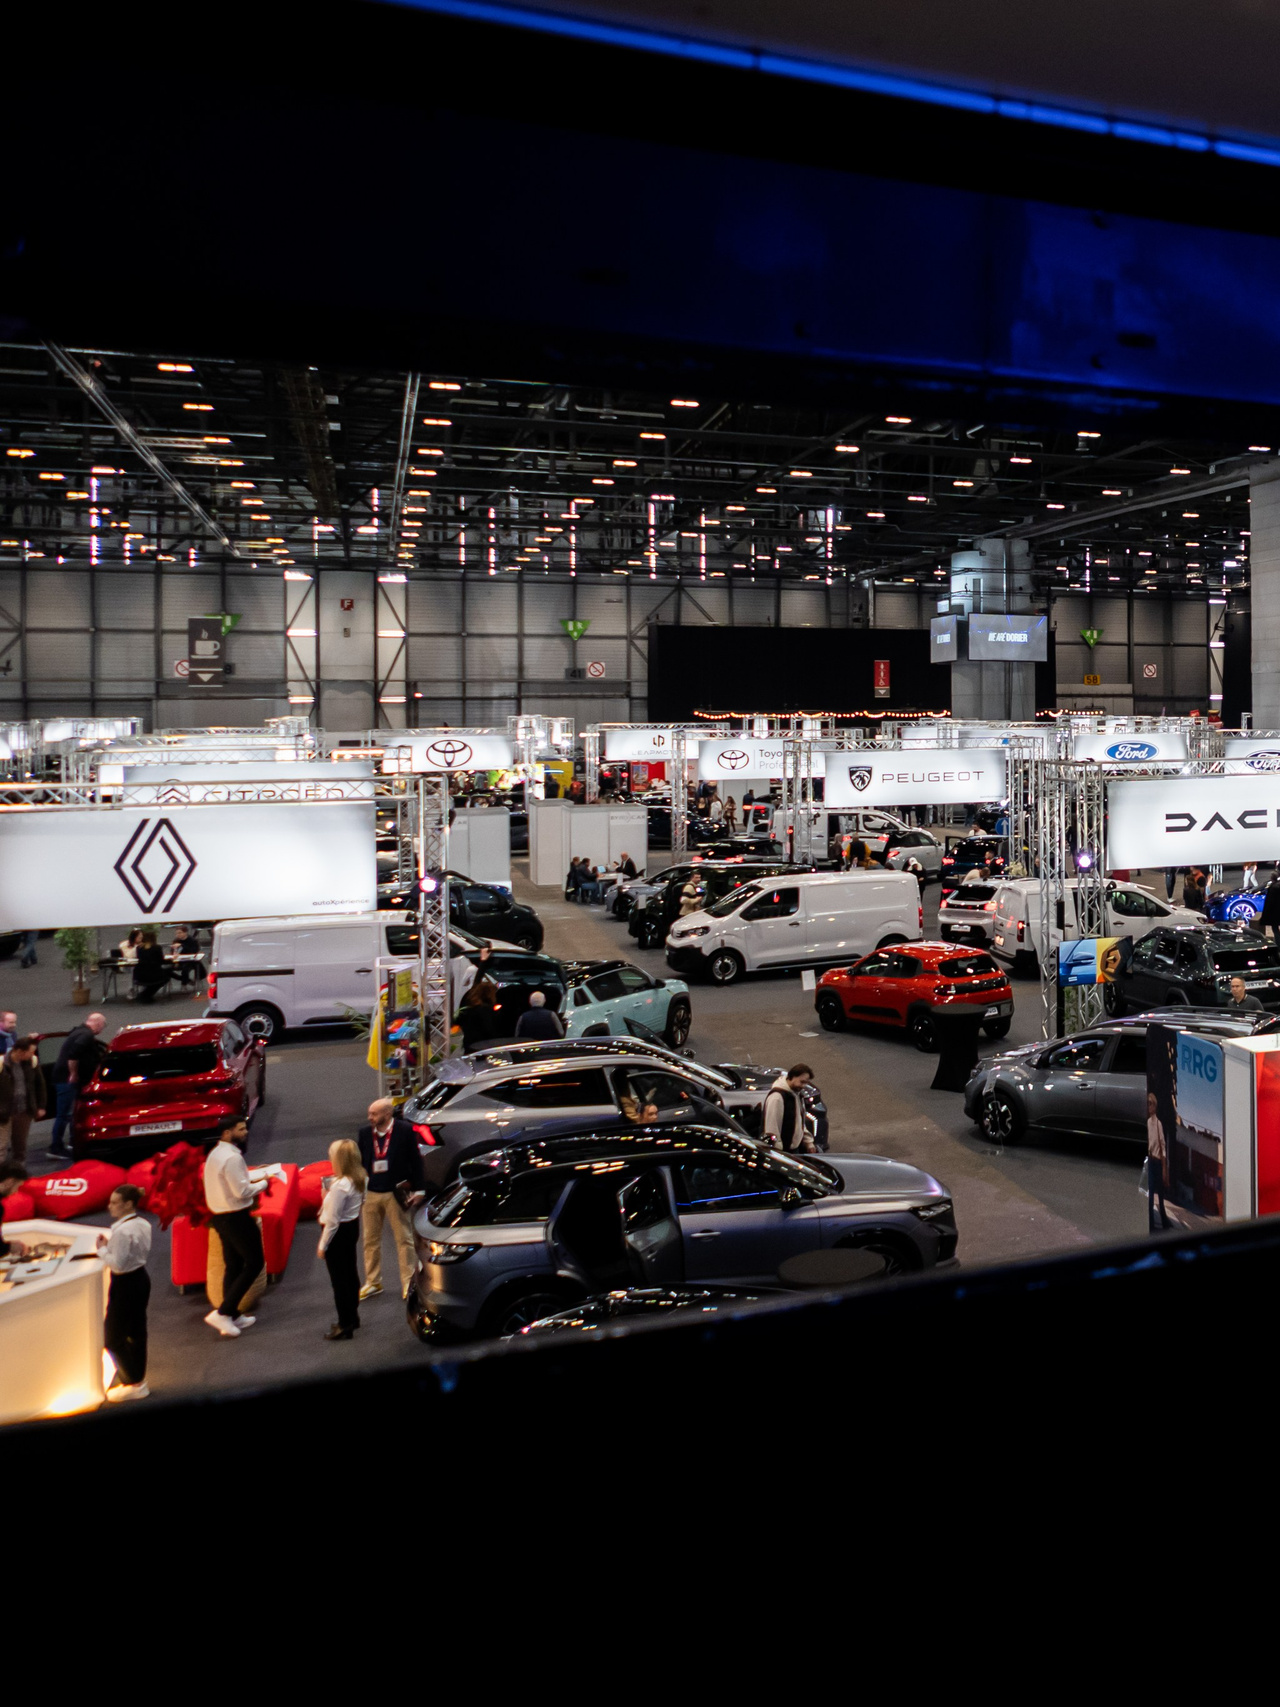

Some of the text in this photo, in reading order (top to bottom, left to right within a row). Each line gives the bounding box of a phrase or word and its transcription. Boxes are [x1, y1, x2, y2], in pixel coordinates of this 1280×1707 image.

[570, 669, 582, 678] 41
[1086, 675, 1099, 684] 58
[759, 749, 793, 759] Toyoa
[1115, 743, 1149, 760] Ford
[882, 770, 985, 783] PEUGEOT
[1182, 1044, 1218, 1083] RRG
[135, 1121, 177, 1132] RENAULT
